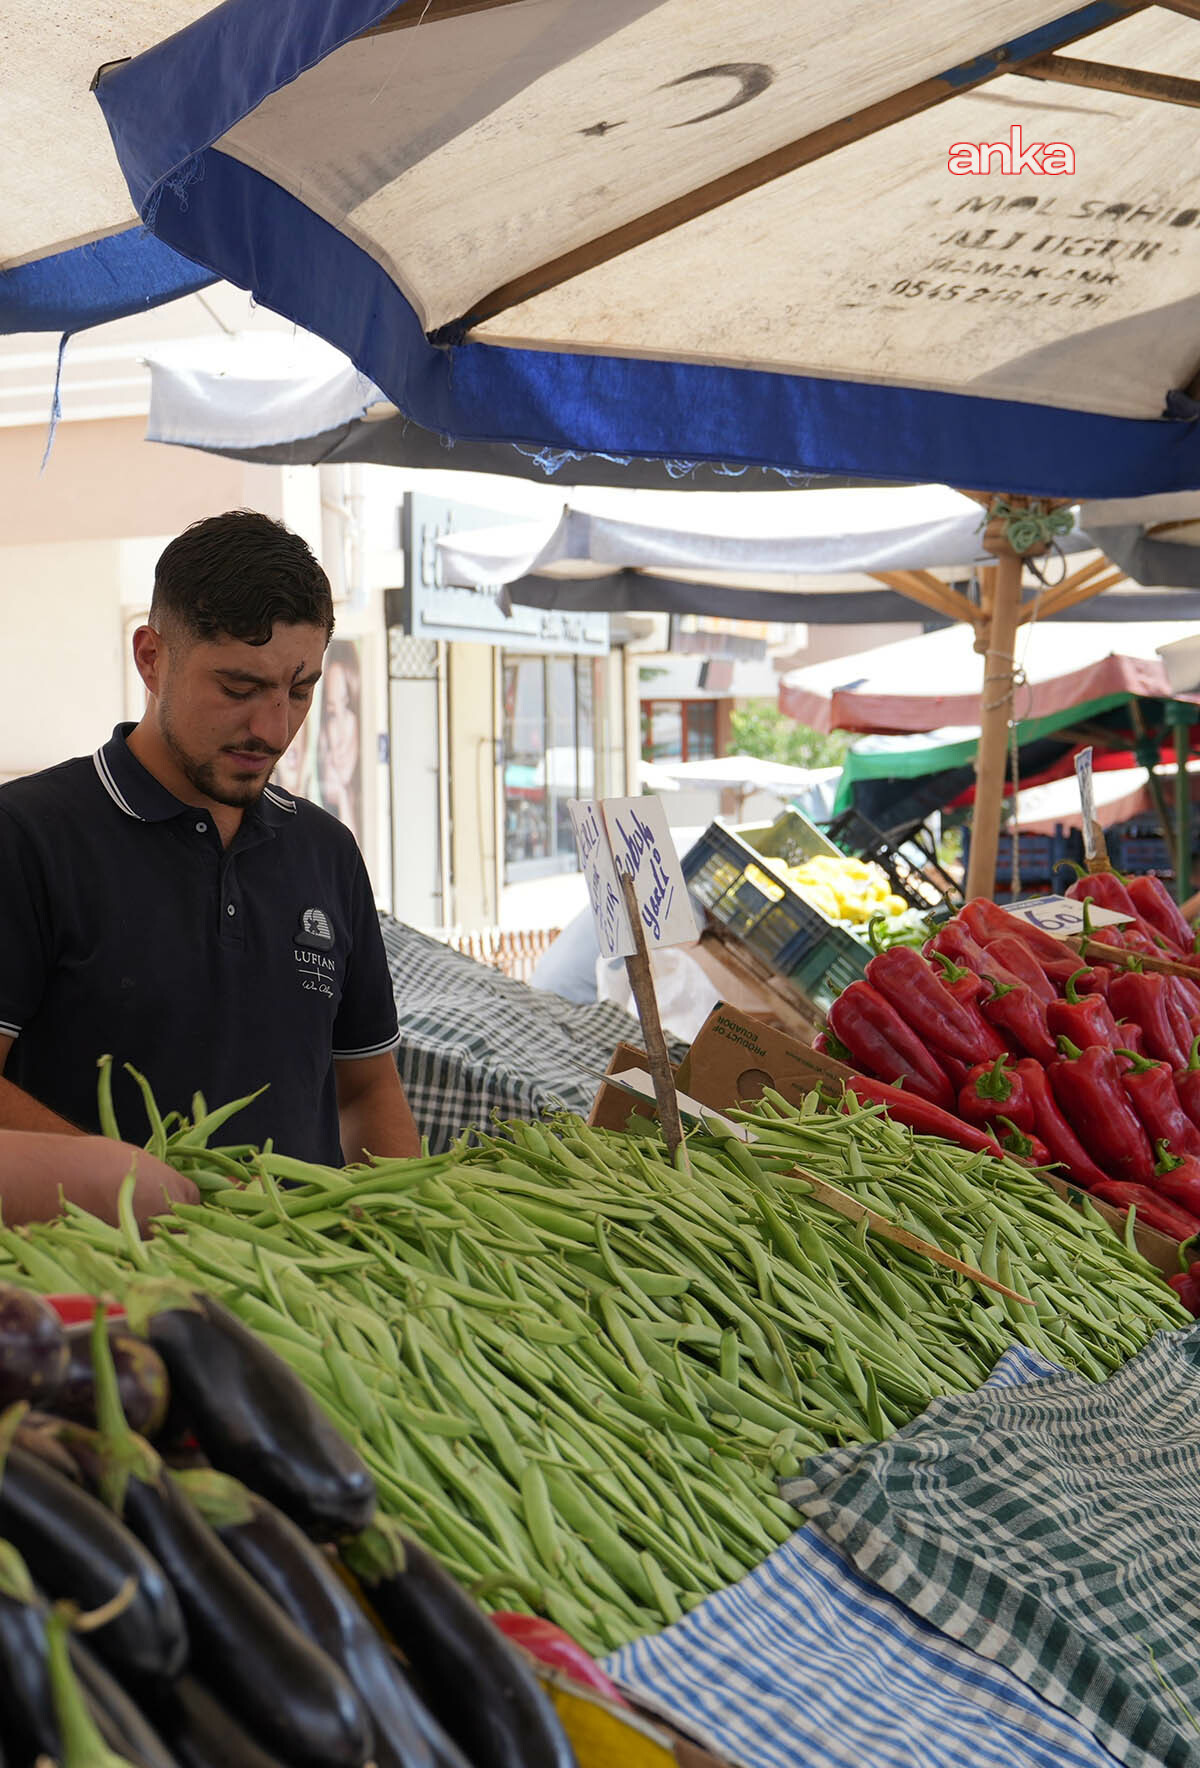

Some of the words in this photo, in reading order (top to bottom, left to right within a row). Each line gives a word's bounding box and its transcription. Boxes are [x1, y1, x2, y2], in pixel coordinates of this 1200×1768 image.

[294, 950, 335, 971] LUFIAN
[712, 1025, 726, 1037] OF
[718, 1016, 758, 1042] ECUADOR
[726, 1031, 767, 1057] PRODUCT
